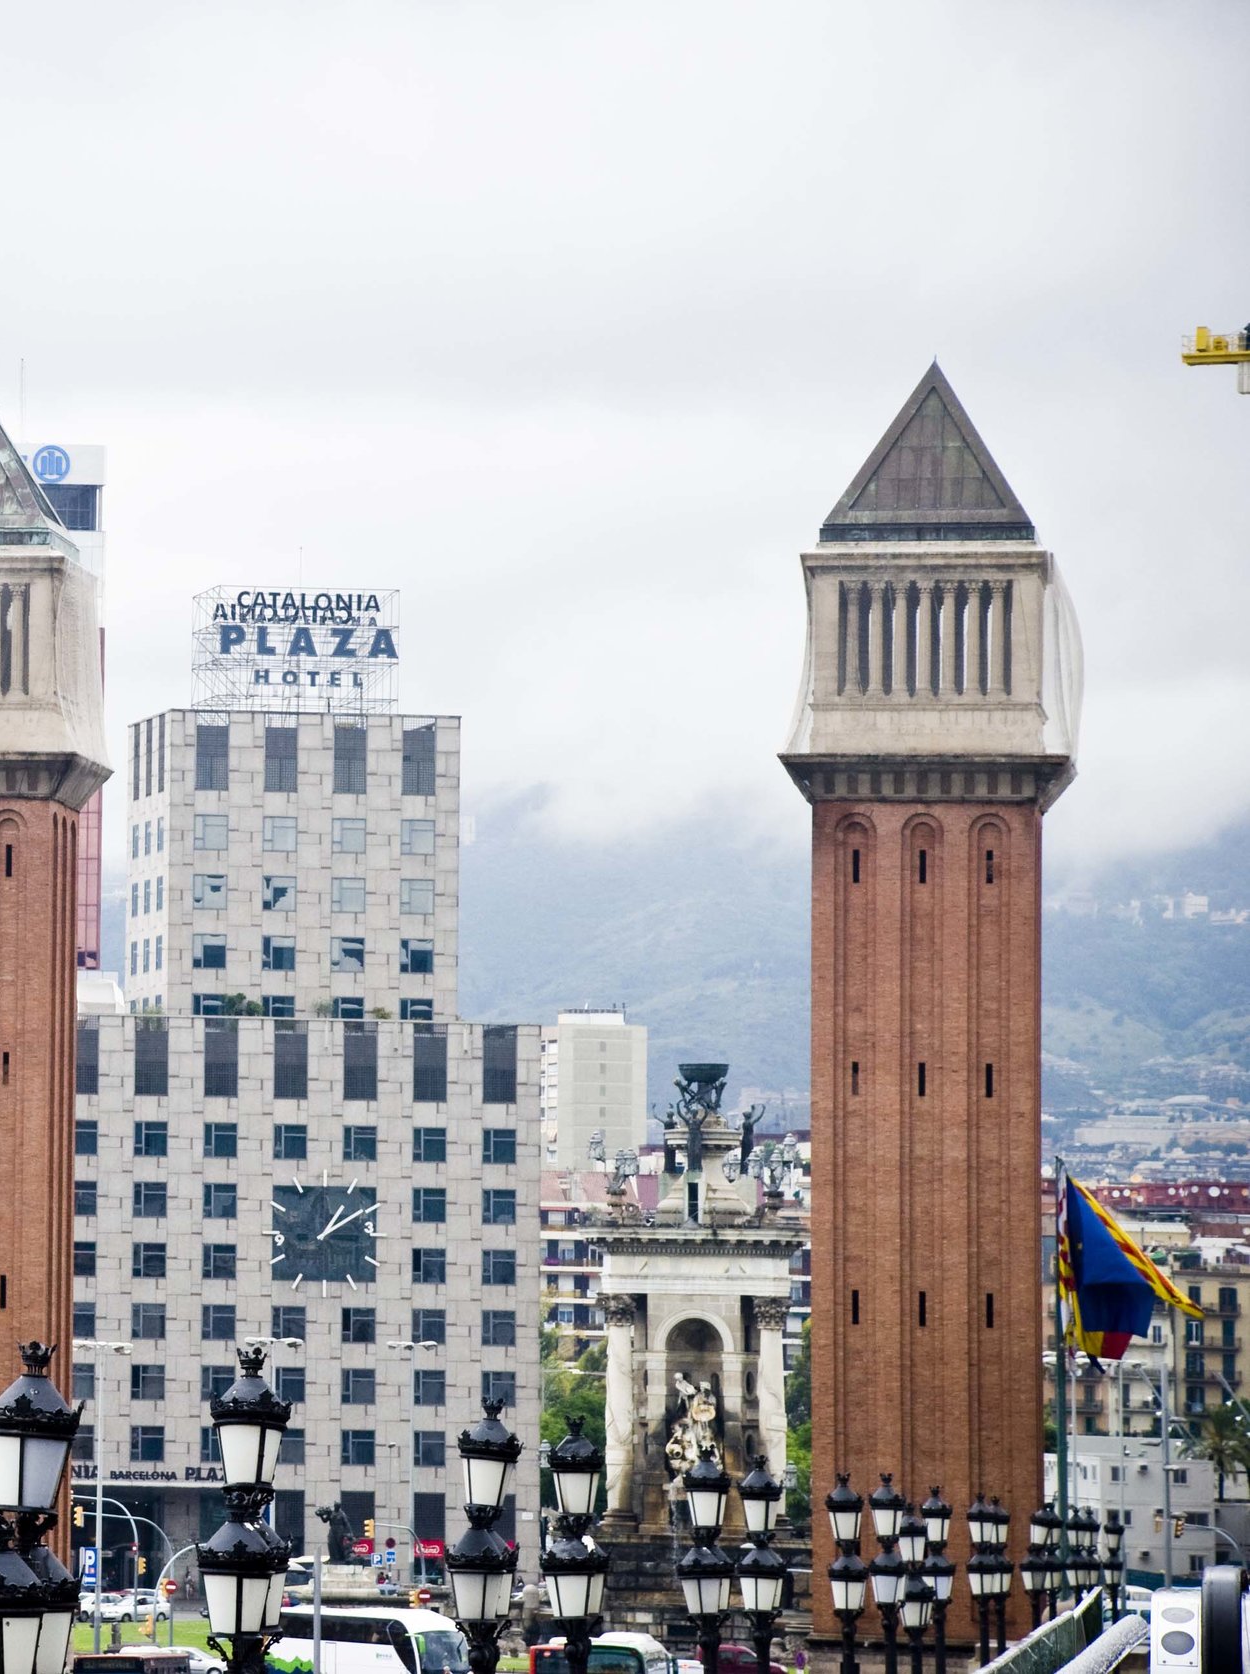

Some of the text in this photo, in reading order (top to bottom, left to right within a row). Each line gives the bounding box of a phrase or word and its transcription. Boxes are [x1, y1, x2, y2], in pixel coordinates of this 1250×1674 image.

[237, 591, 380, 612] CATALONIA
[219, 625, 399, 658] PLAZA
[254, 669, 363, 687] HOTEL
[364, 1222, 374, 1234] 3
[274, 1234, 285, 1246] 9
[110, 1471, 178, 1481] BARCELONA
[185, 1467, 225, 1481] PLA
[85, 1549, 96, 1574] P
